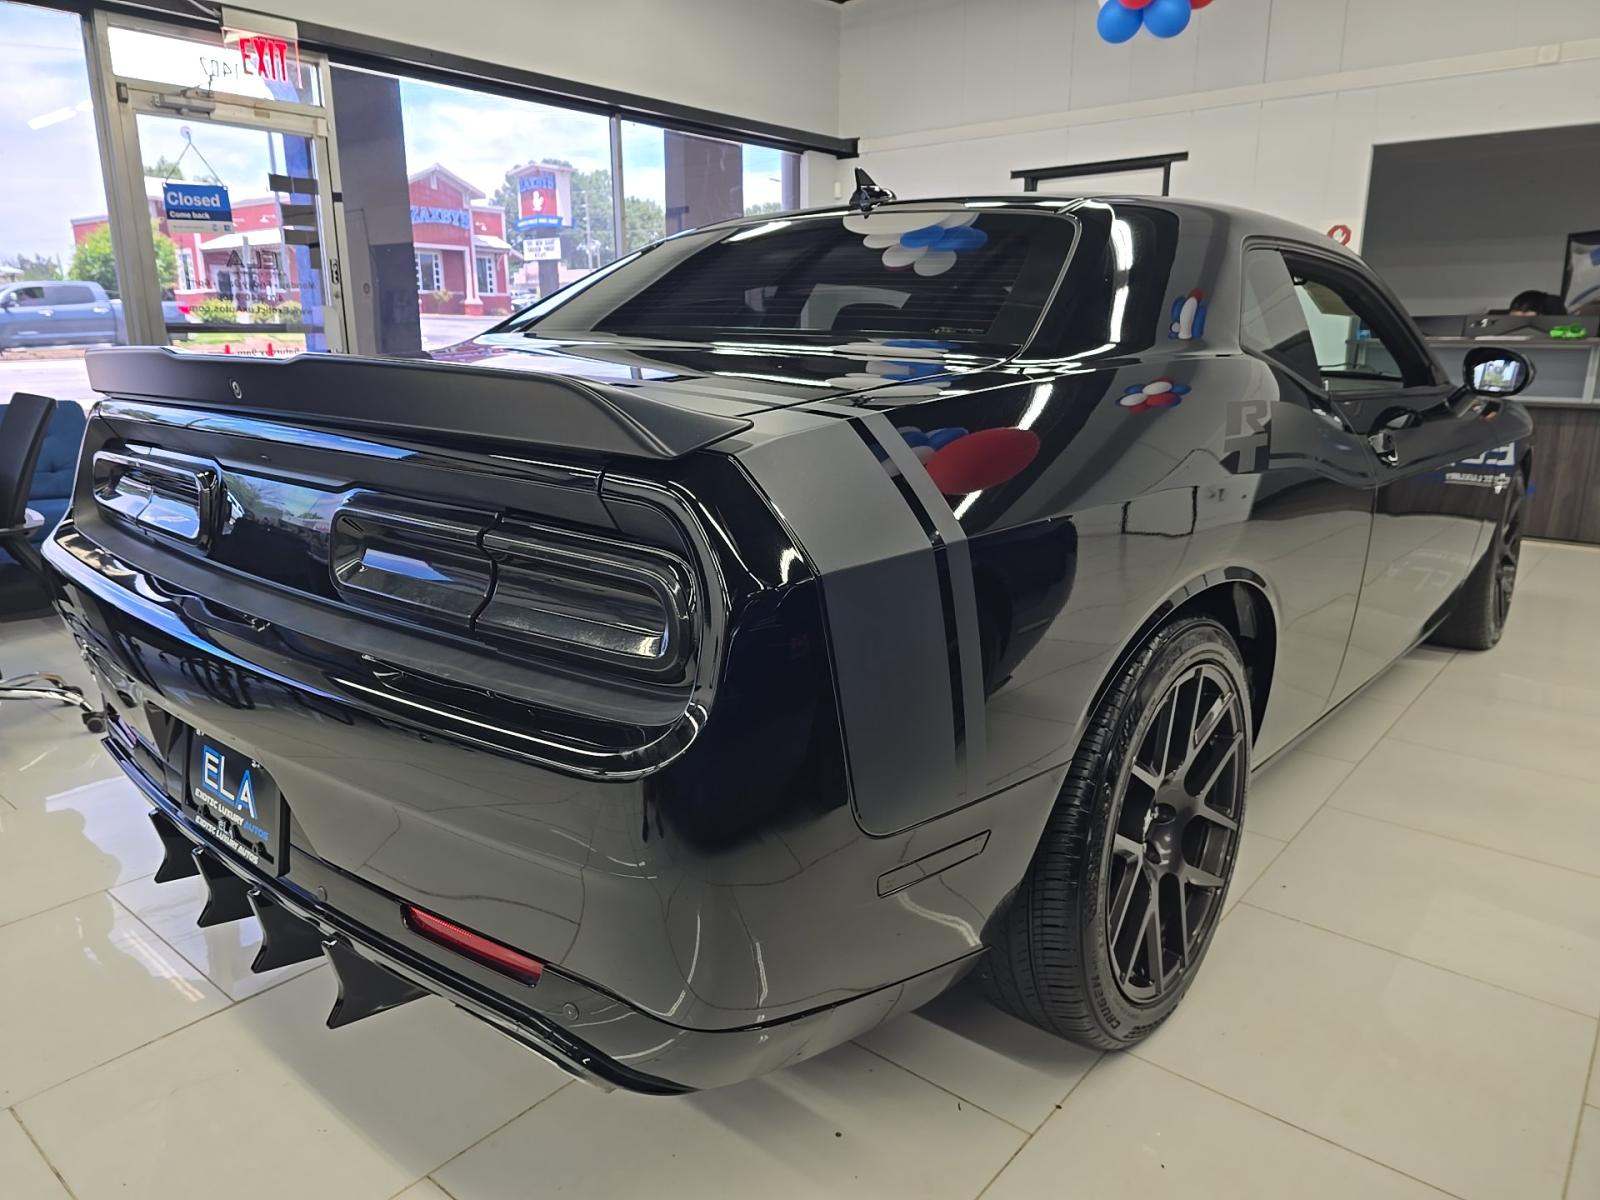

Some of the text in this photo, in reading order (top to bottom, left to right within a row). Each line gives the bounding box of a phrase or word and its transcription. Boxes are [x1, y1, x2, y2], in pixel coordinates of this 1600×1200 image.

[240, 37, 288, 81] EXIT
[166, 191, 220, 207] Closed
[169, 211, 210, 219] Come back
[203, 745, 257, 819] ELA
[218, 803, 244, 826] LUXURY
[243, 821, 270, 841] AUTOS
[237, 845, 259, 865] AUTOS
